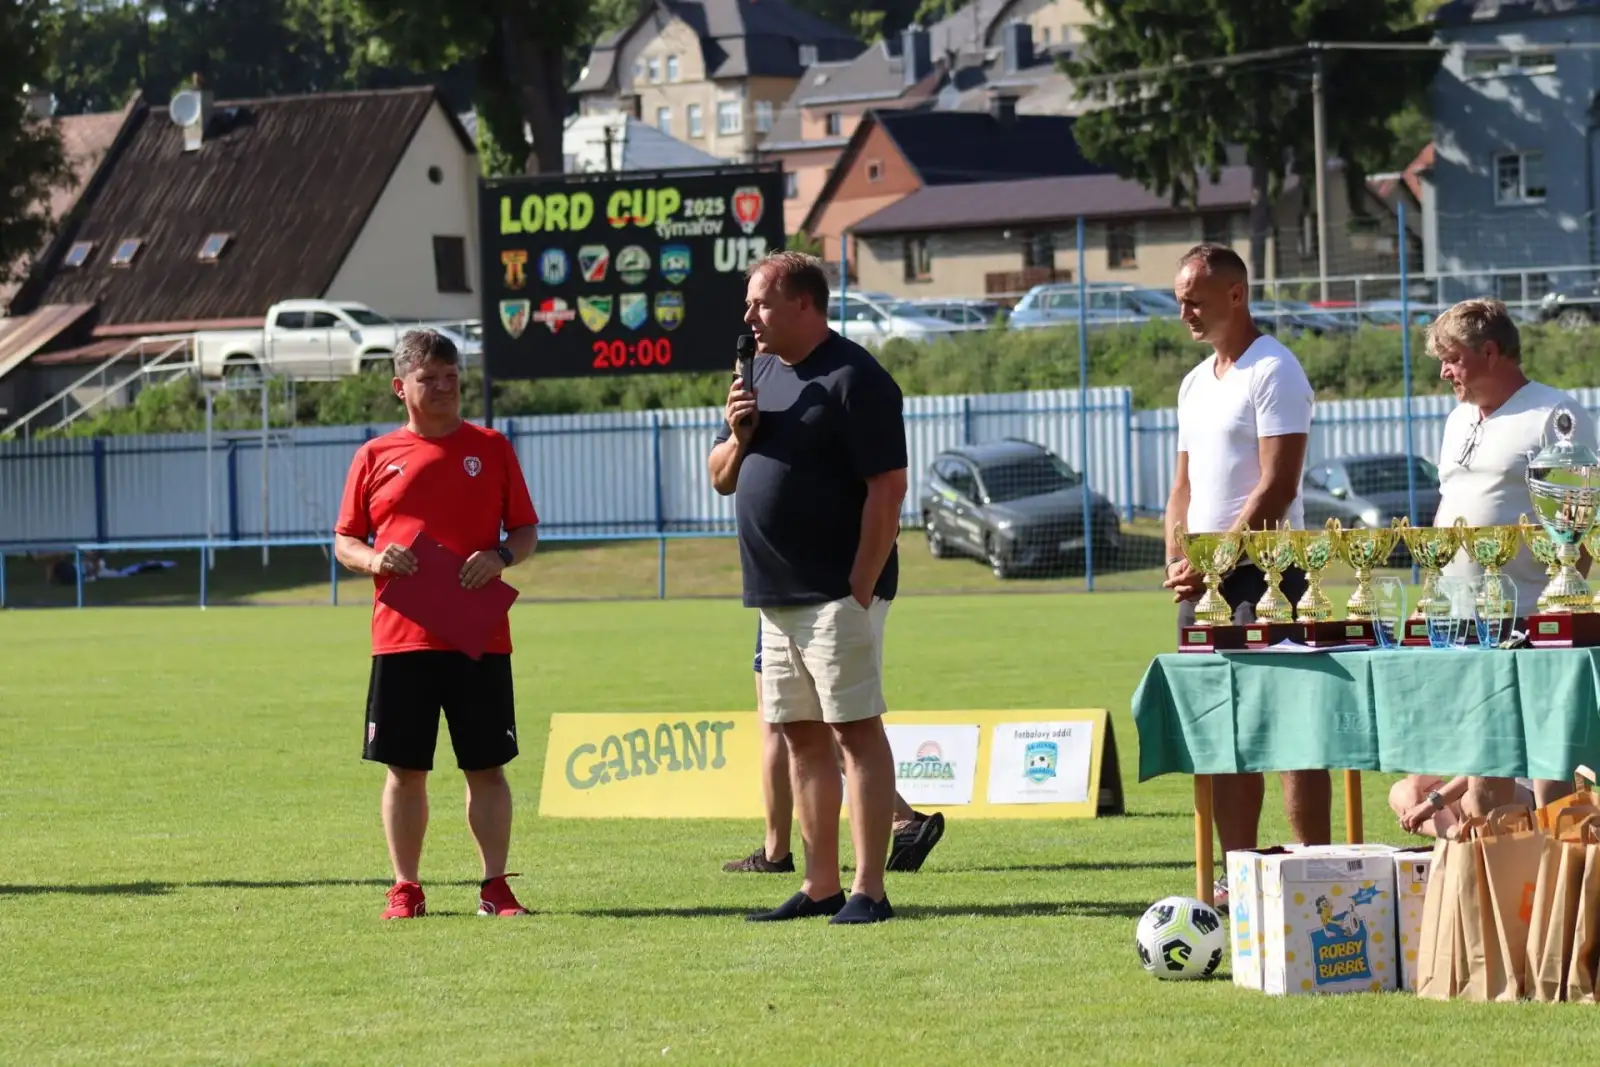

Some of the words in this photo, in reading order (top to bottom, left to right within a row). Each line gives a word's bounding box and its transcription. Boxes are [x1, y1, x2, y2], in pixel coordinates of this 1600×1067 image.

[500, 192, 594, 235] LORD
[606, 187, 681, 229] CUP
[684, 197, 725, 217] 2025
[592, 337, 671, 369] 20:00
[565, 720, 735, 790] GARANT
[897, 761, 955, 779] HOLBA
[1318, 940, 1363, 961] ROBBY
[1319, 956, 1367, 978] BUBBLE
